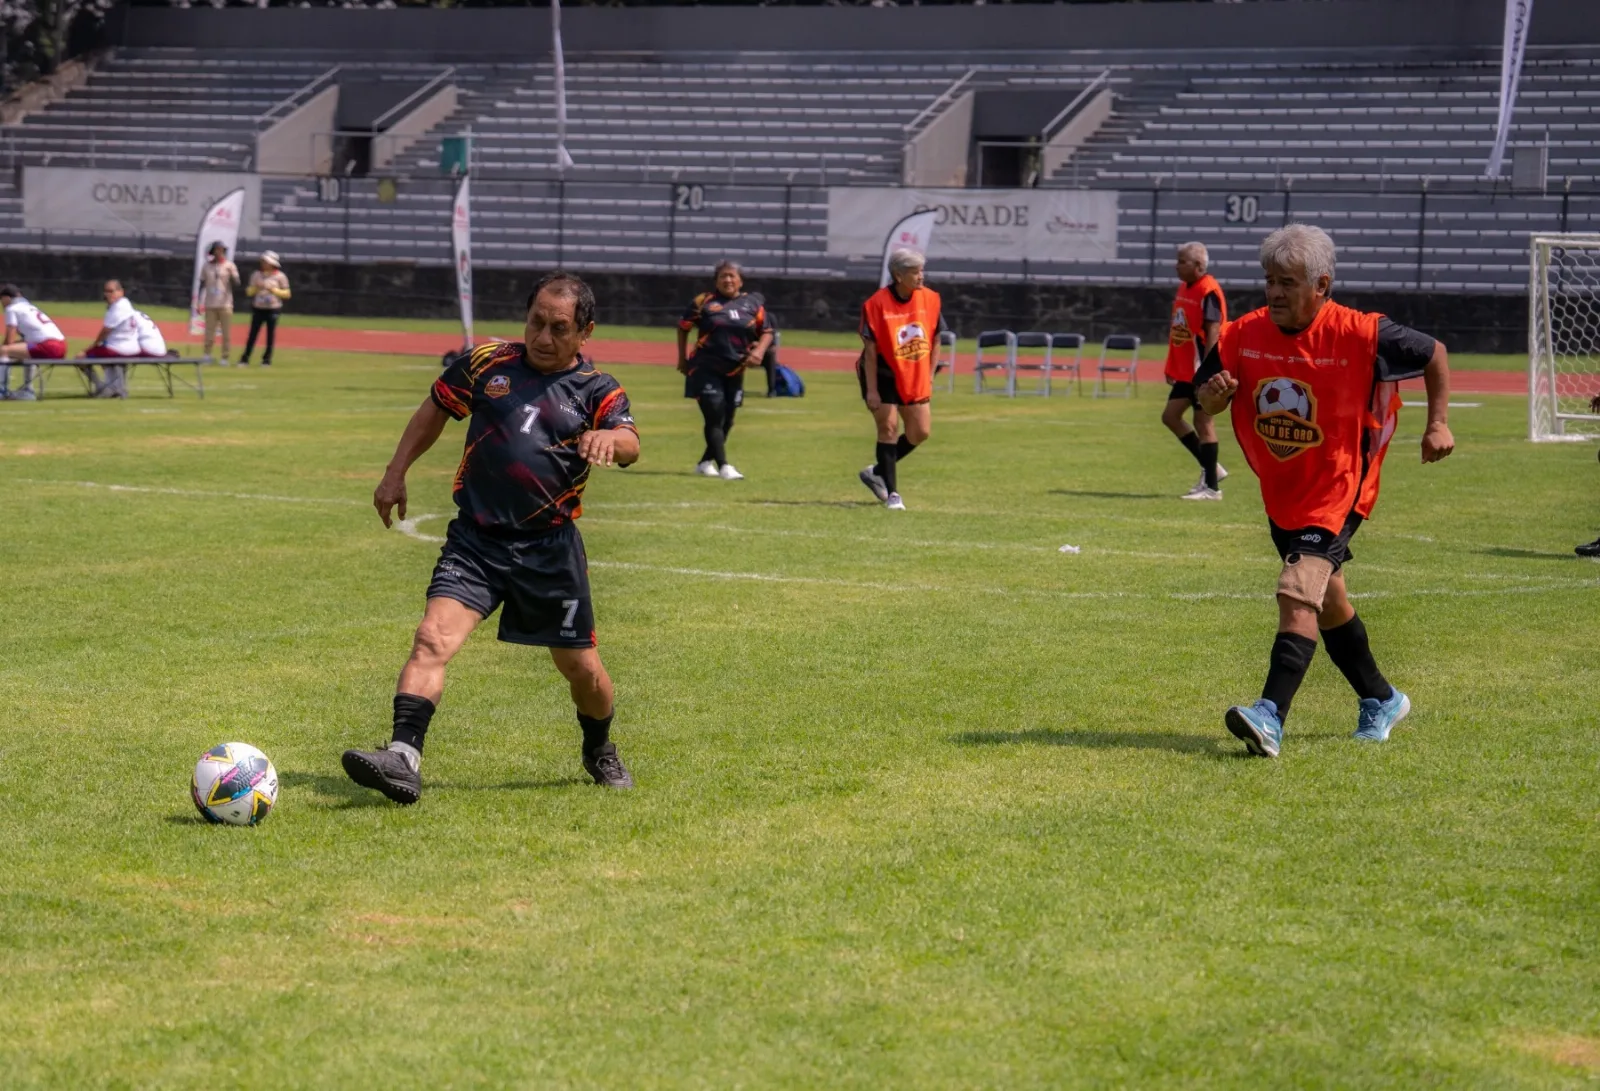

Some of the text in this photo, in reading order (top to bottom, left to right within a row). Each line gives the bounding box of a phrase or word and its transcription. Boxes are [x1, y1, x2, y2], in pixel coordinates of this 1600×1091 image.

[92, 182, 188, 205] CONADE
[321, 177, 339, 201] 10
[677, 185, 703, 210] 20
[1227, 195, 1257, 222] 30
[520, 403, 540, 434] 7
[1278, 426, 1291, 439] DE
[1293, 428, 1313, 441] ORO
[562, 599, 579, 628] 7
